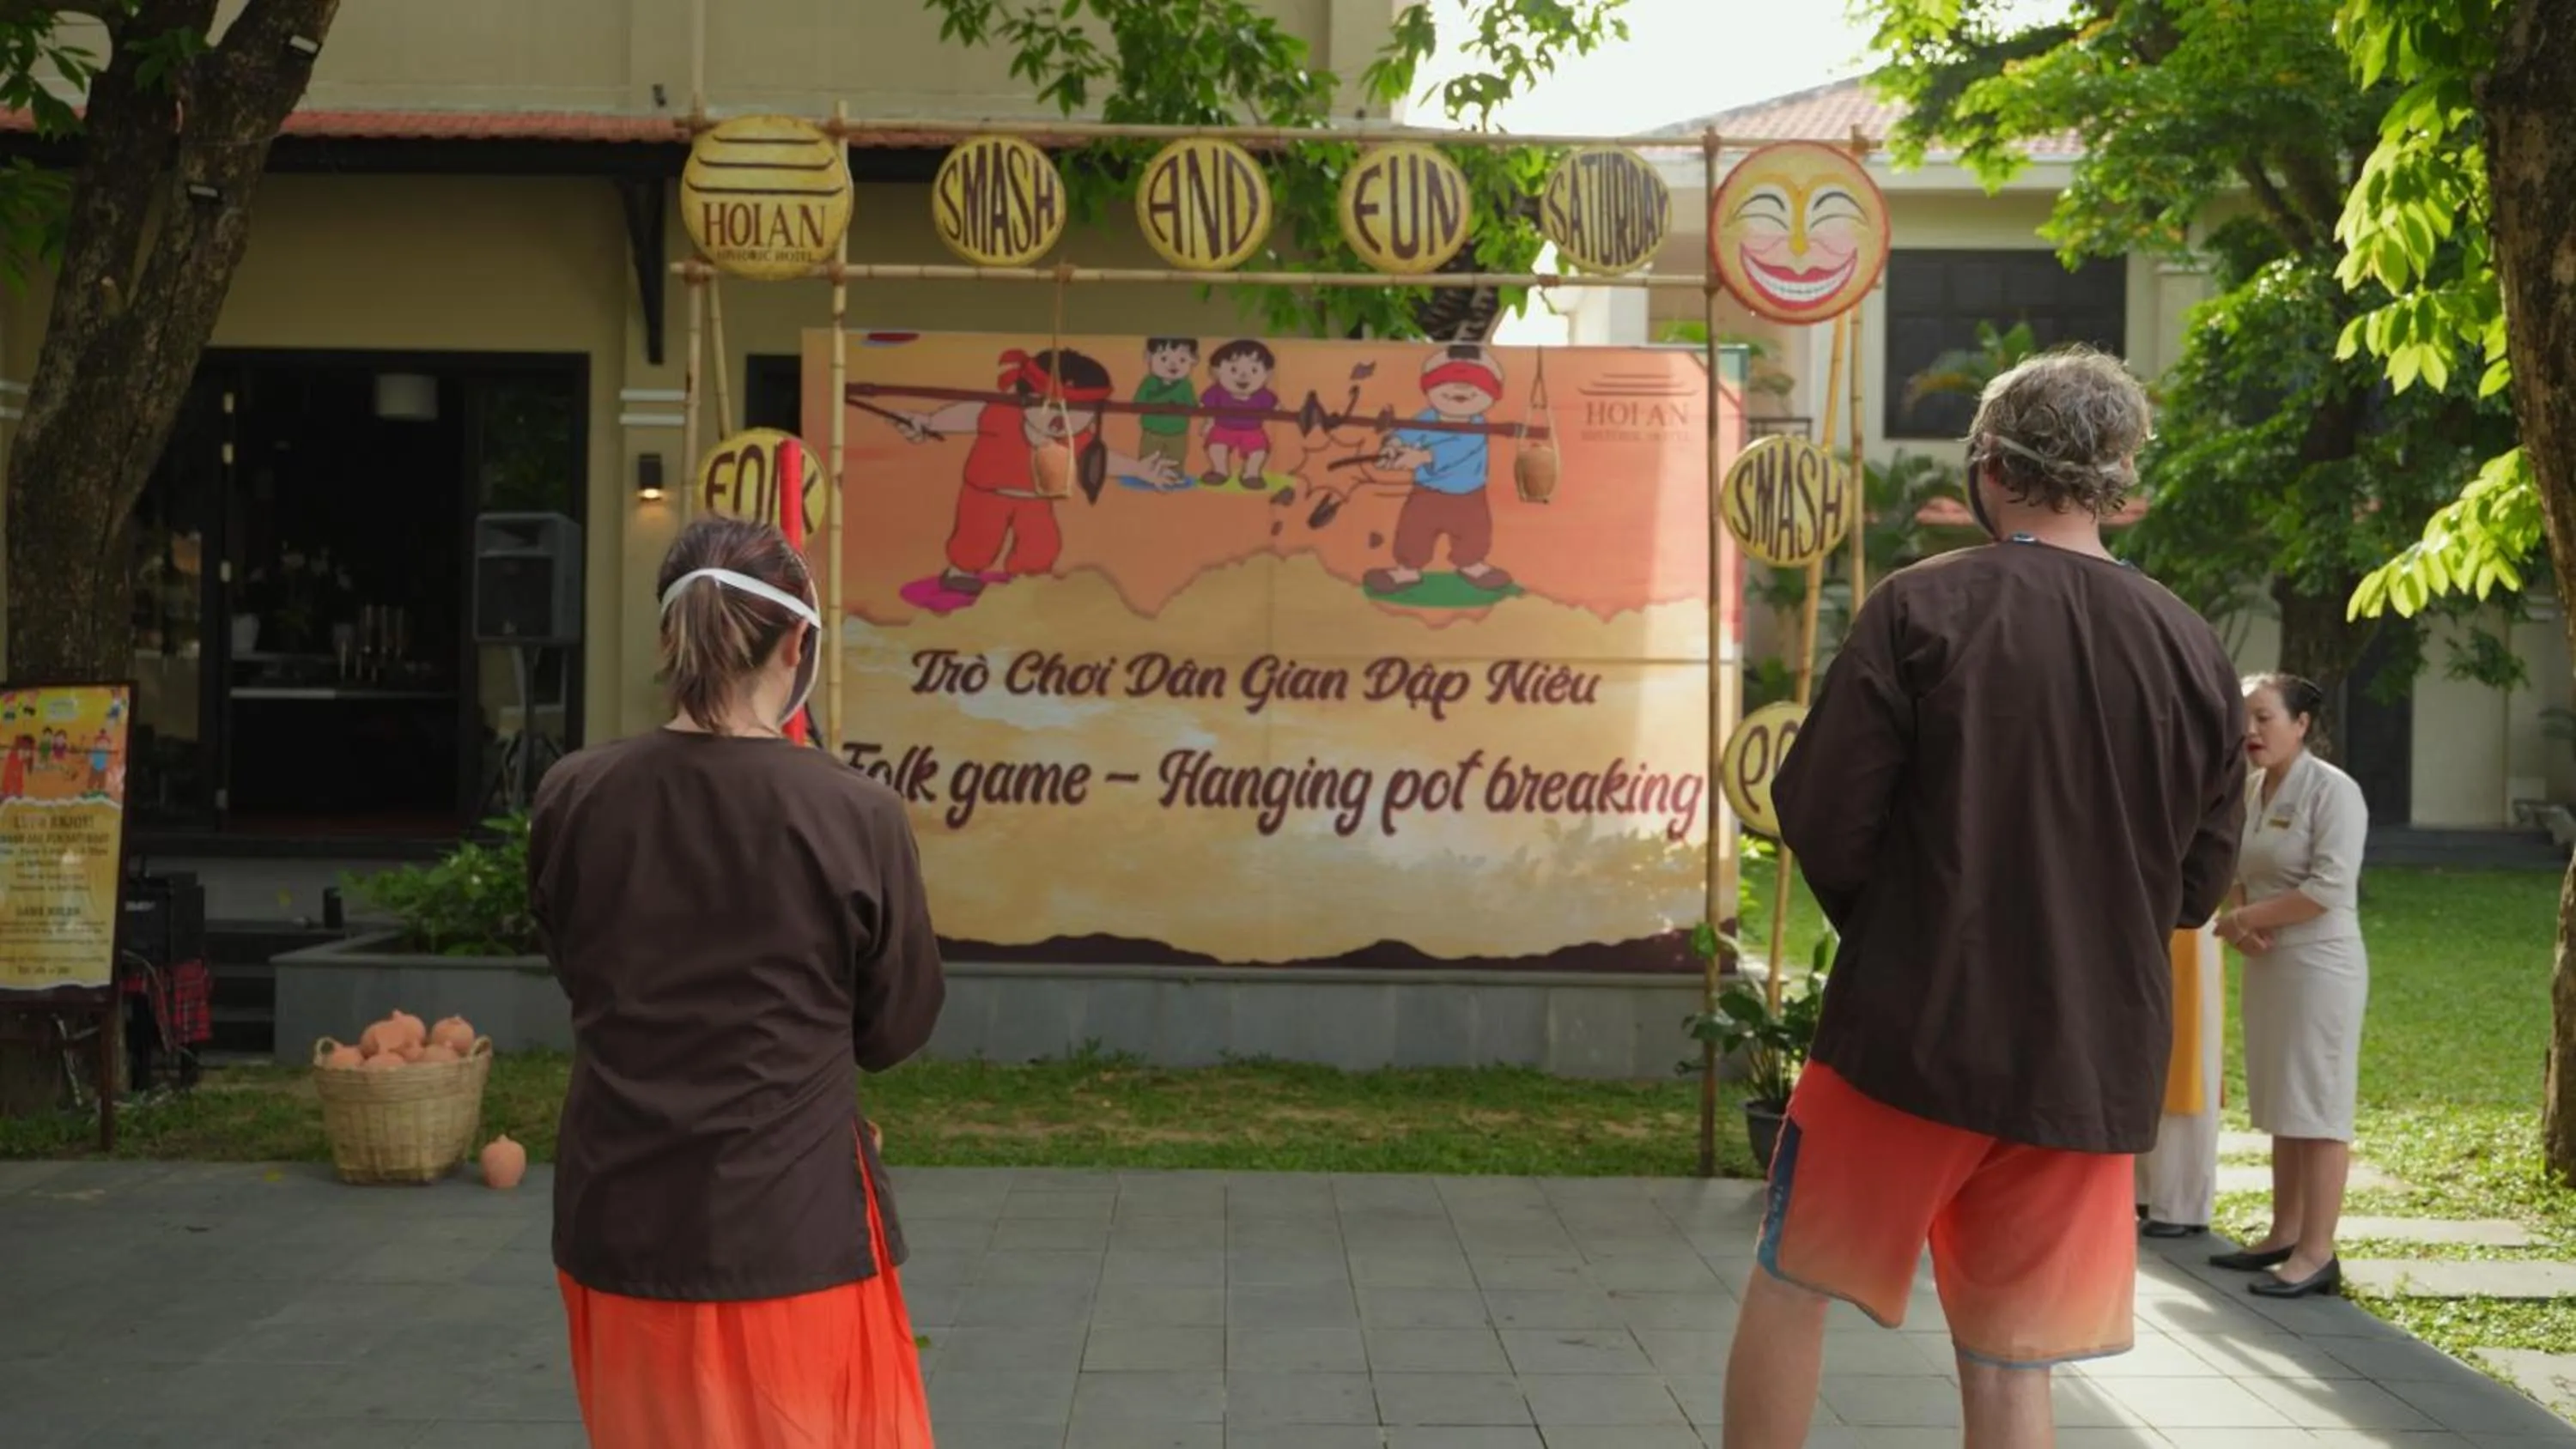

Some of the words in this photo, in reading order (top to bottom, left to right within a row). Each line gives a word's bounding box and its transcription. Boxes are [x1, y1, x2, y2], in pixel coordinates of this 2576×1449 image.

[939, 142, 1055, 256] SMASH
[1148, 146, 1260, 260] AND
[1352, 154, 1459, 260] FUN
[1547, 150, 1669, 266] SATURDAY
[1731, 442, 1843, 561] SMASH
[910, 648, 990, 694] Trò
[1004, 649, 1117, 697] Chơi
[1124, 652, 1227, 699] Dân
[1240, 653, 1349, 714] Gian
[1362, 656, 1470, 721] Đập
[1484, 659, 1603, 705] Niêu
[945, 760, 1091, 829] game
[1157, 749, 1373, 837] Hanging
[1381, 749, 1485, 837] pot
[1484, 755, 1704, 840] breaking
